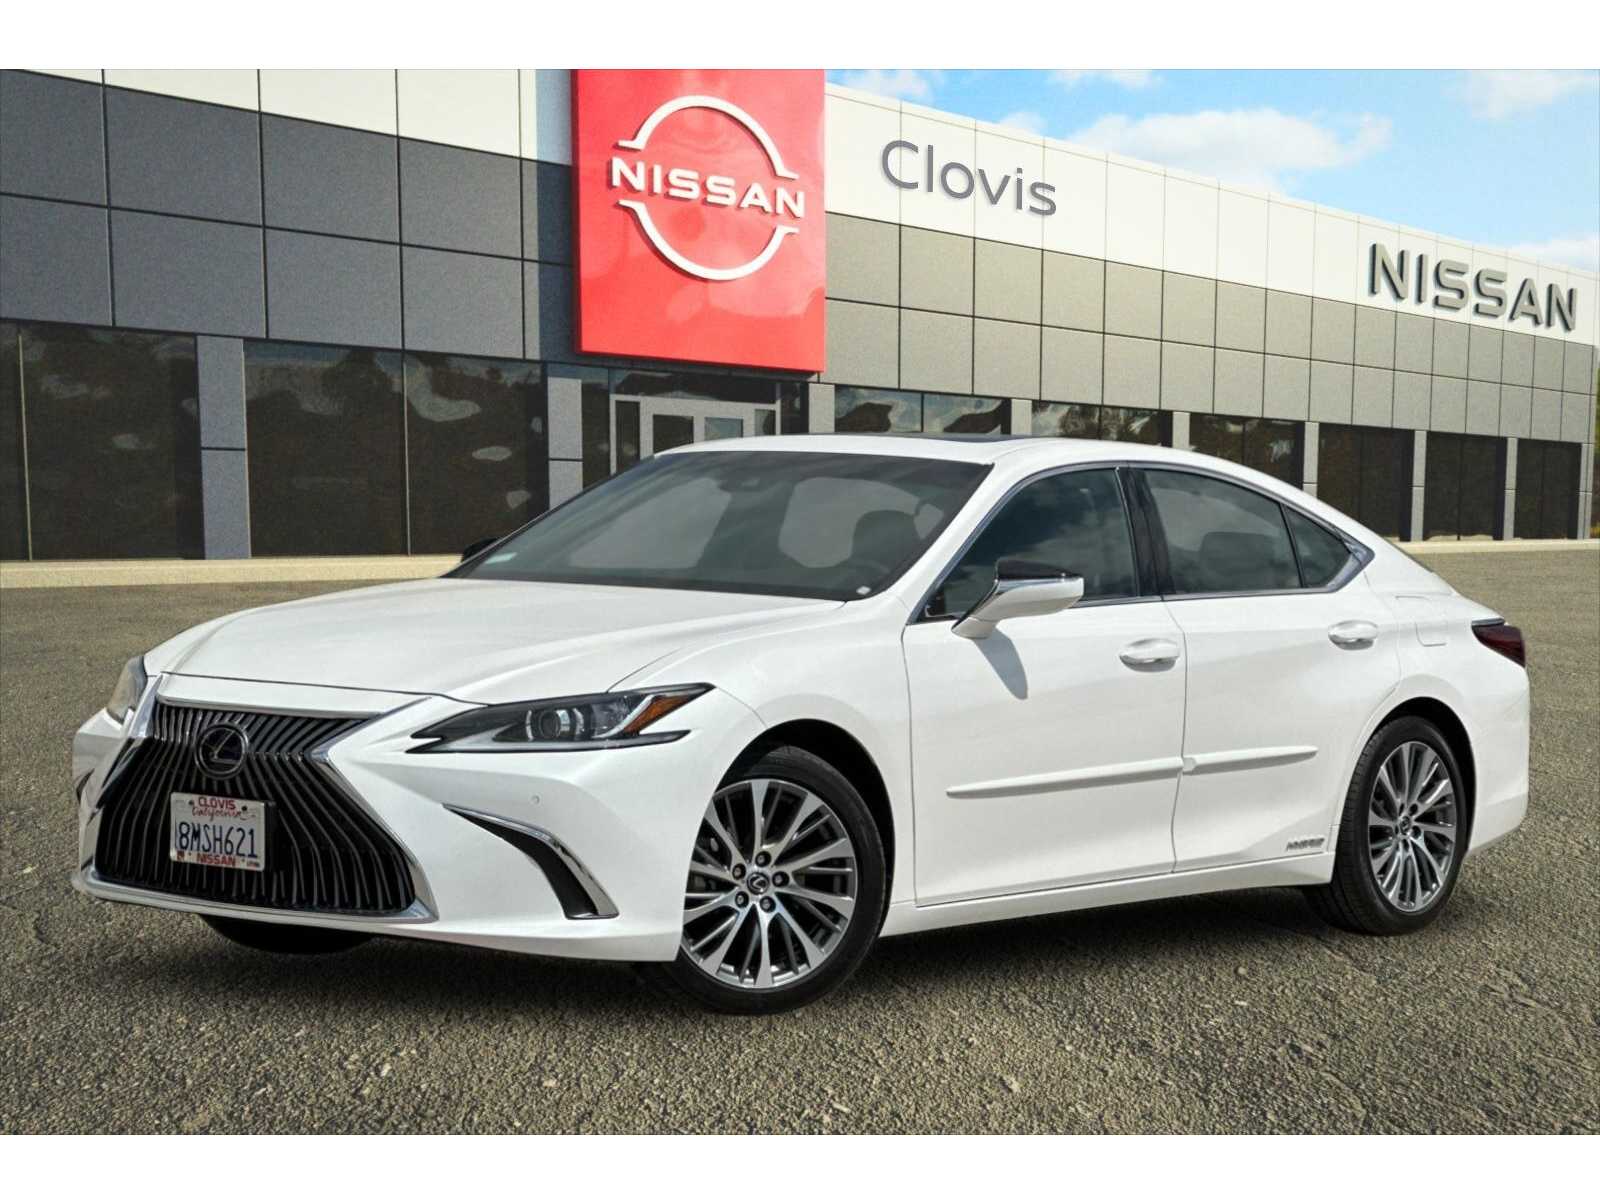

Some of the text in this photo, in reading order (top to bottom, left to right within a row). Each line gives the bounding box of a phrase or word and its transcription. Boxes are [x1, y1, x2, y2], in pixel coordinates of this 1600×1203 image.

[611, 156, 805, 218] NISSAN
[881, 140, 1057, 216] Clovis
[1369, 242, 1577, 331] NISSAN
[198, 796, 236, 810] CLOVIS
[178, 821, 257, 858] 8MSH621
[197, 853, 236, 867] NISSAN
